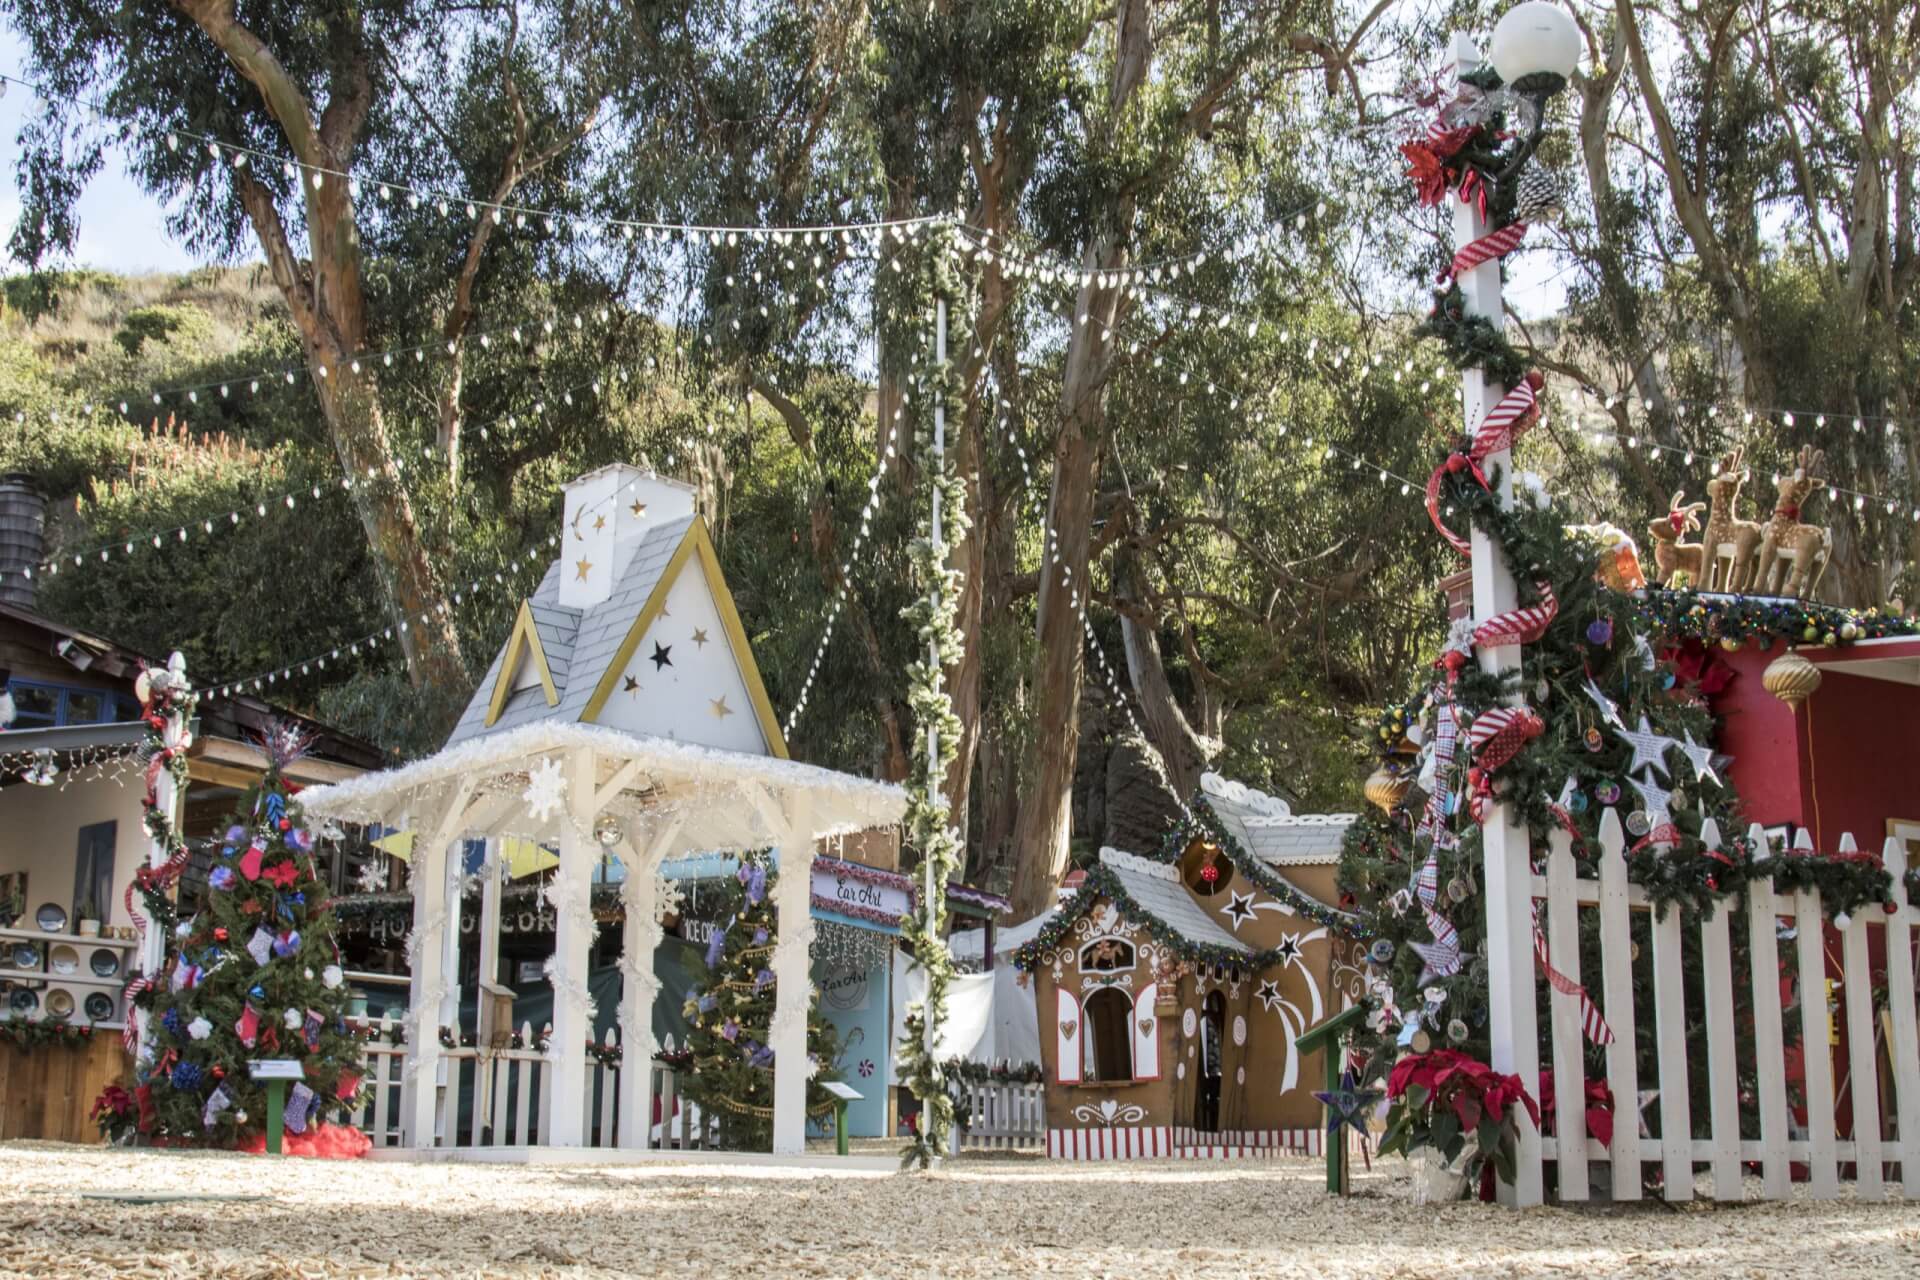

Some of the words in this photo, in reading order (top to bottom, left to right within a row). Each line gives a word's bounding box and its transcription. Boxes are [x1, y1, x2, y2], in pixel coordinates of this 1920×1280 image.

[836, 879, 856, 901] Ear
[858, 885, 882, 907] Art
[369, 918, 406, 938] HU
[685, 918, 700, 942] ICE
